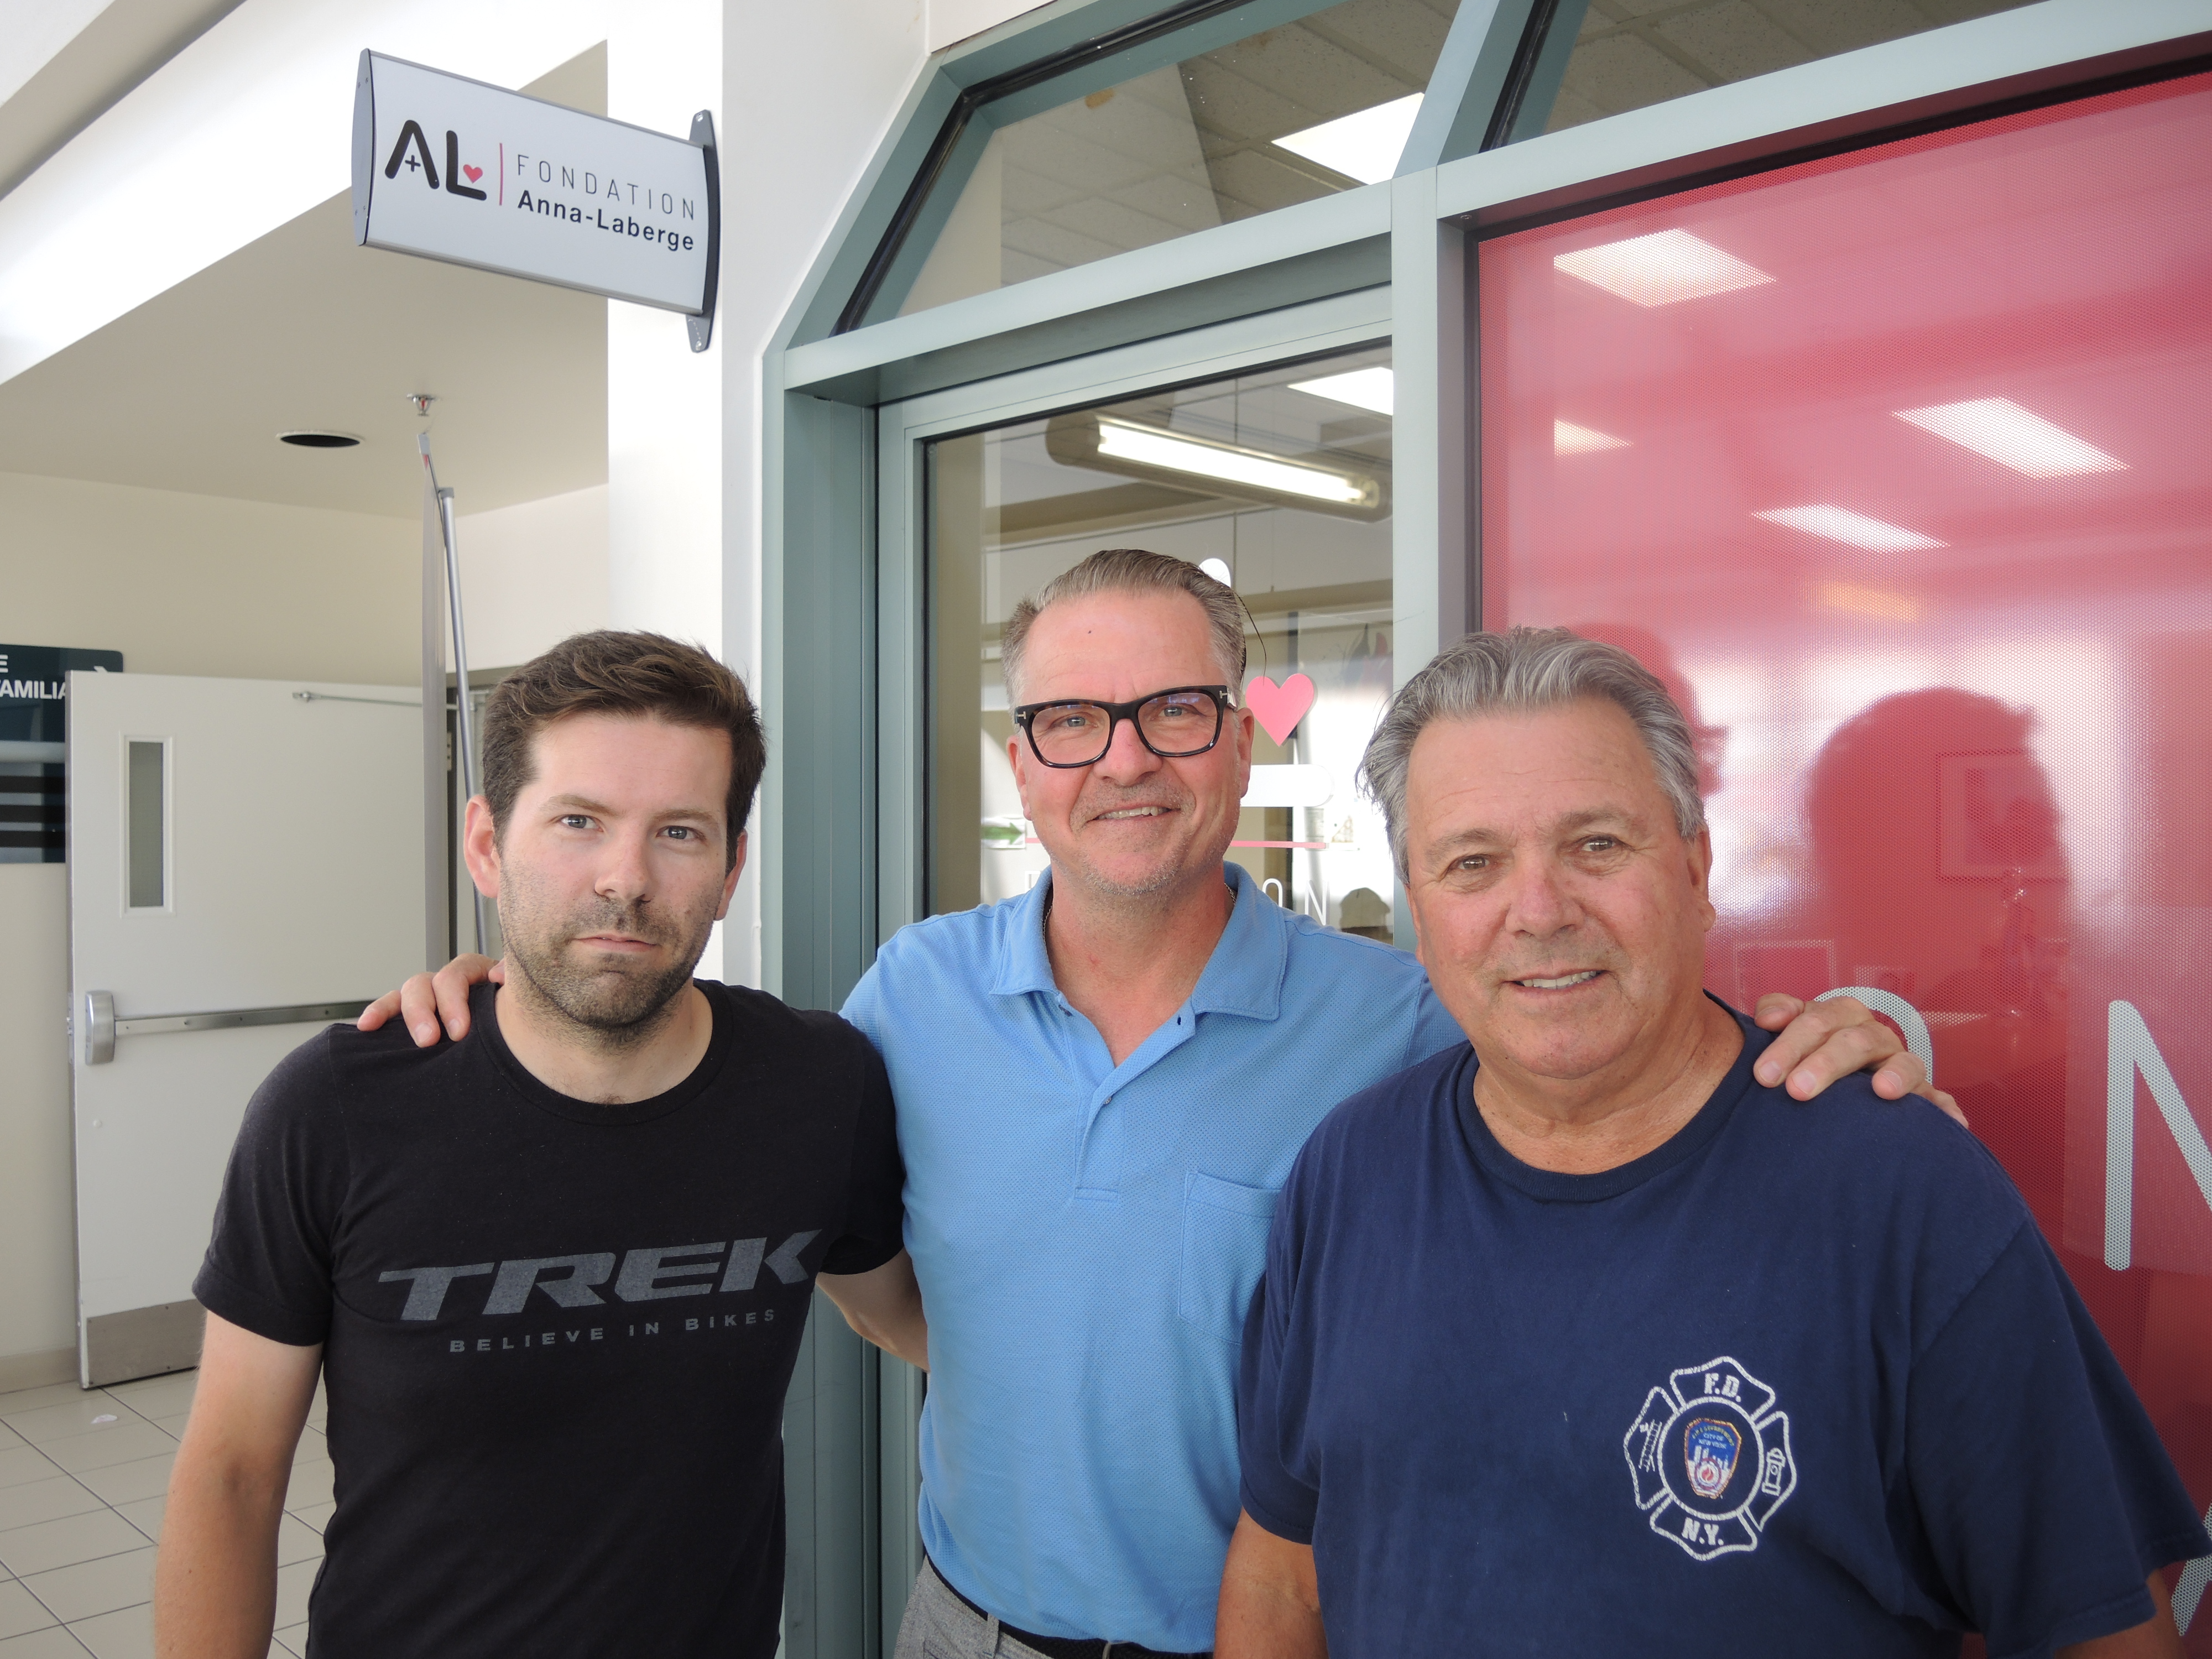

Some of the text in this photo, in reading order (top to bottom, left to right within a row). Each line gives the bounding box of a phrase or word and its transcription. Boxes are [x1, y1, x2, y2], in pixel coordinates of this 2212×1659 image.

[517, 154, 695, 221] FONDATION
[517, 190, 695, 251] Anna-Laberge
[378, 1229, 823, 1321] TREK
[450, 1309, 776, 1353] BELIEVE IN BIKES
[1704, 1373, 1741, 1402] F.D.
[1681, 1517, 1724, 1546] N.Y.
